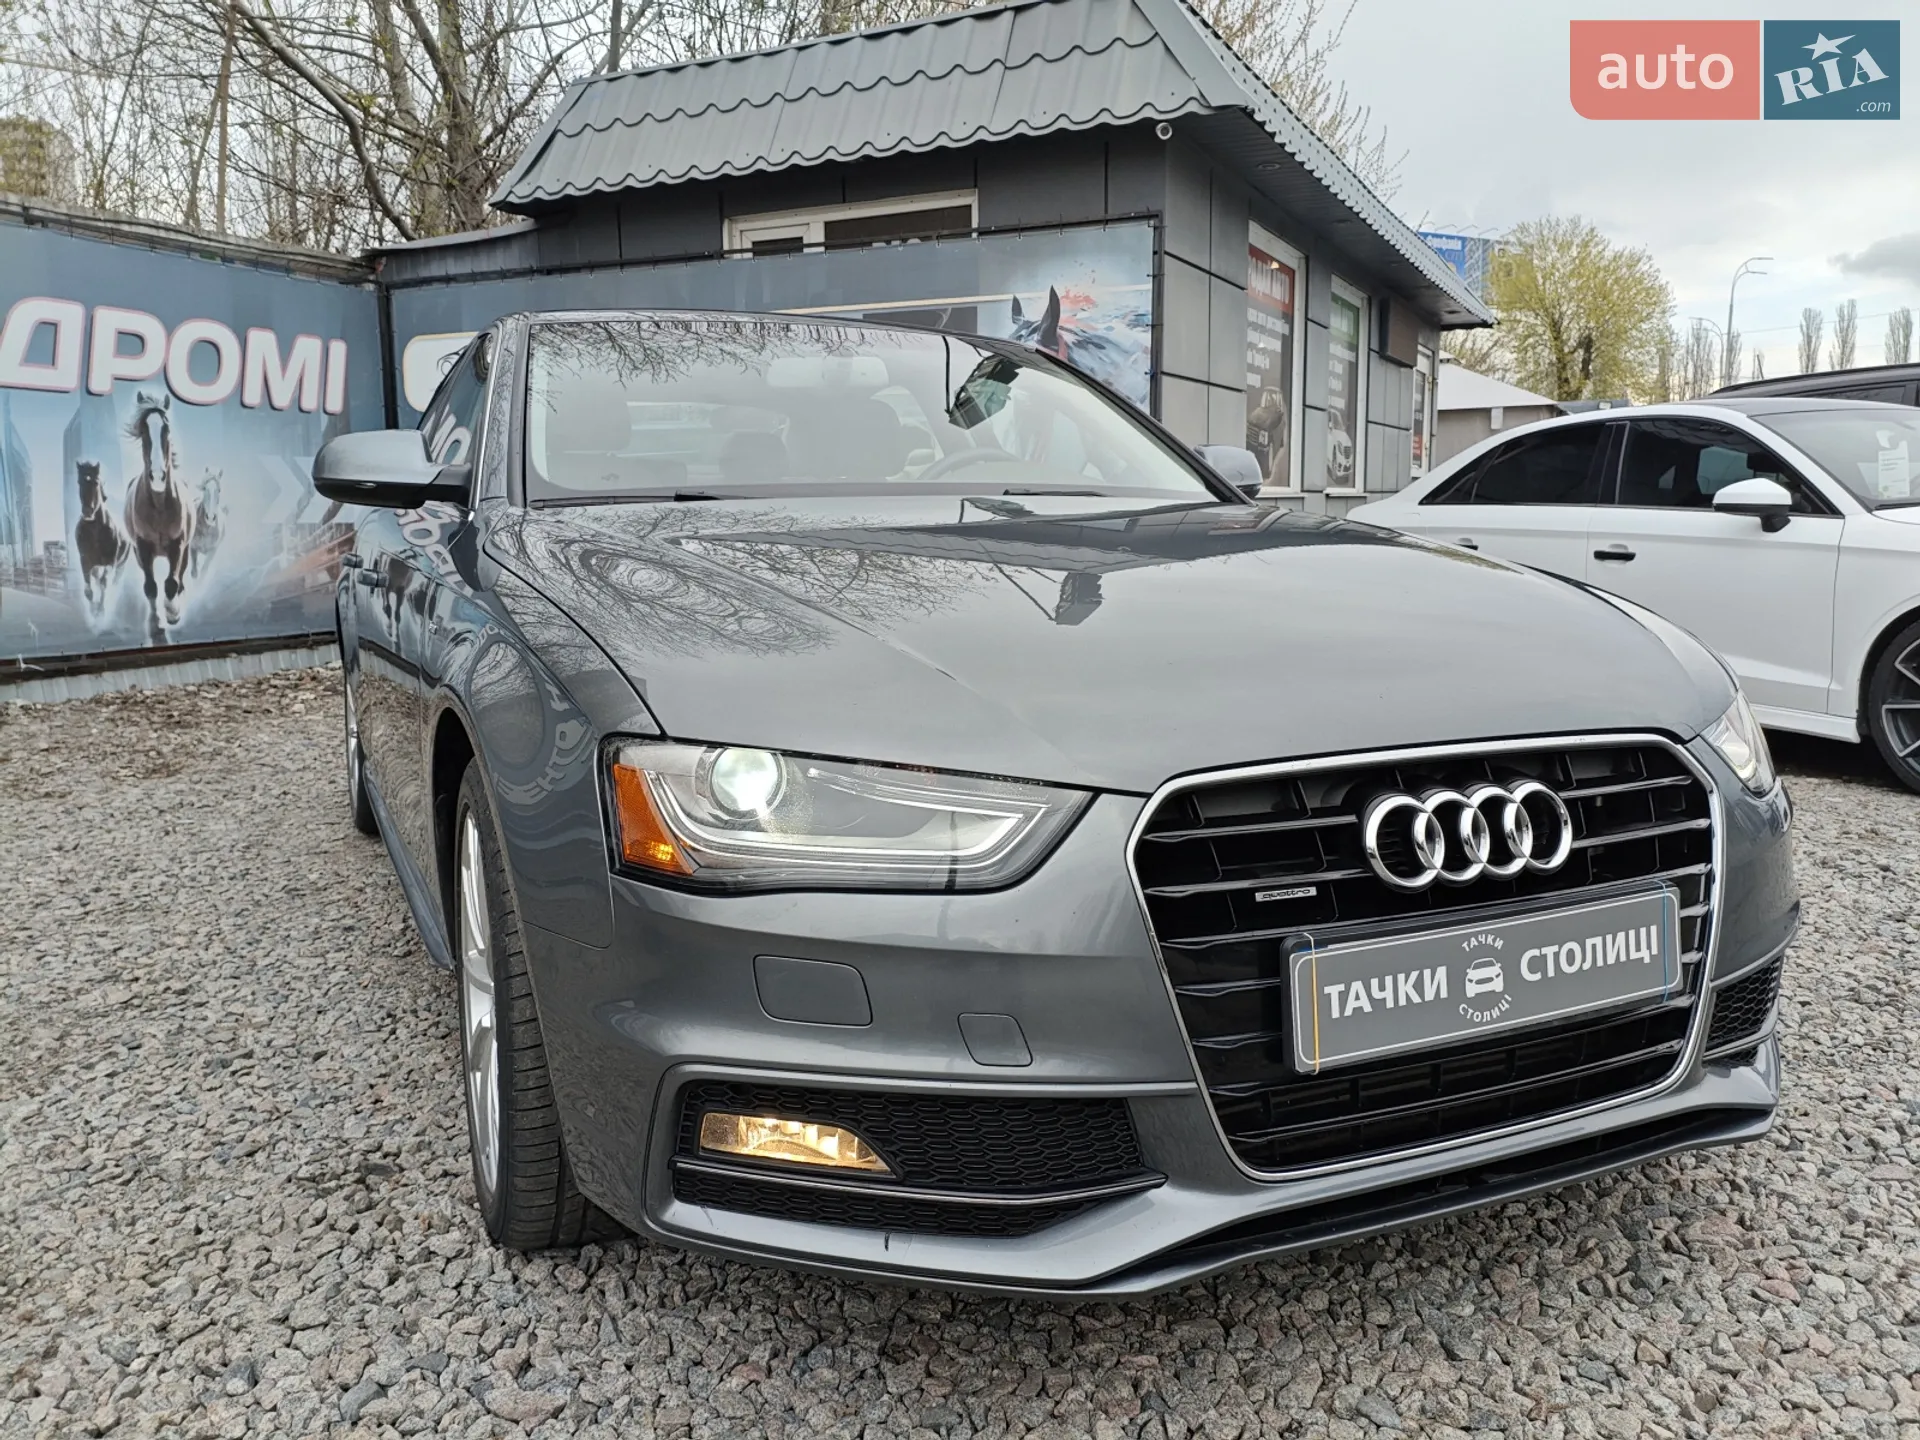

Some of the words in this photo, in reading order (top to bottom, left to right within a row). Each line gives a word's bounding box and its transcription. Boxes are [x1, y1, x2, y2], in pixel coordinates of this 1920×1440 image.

[0, 296, 347, 415] ДРОМІ
[1261, 888, 1311, 900] quattro
[1462, 933, 1504, 951] ТАЧКИ
[1323, 965, 1449, 1019] ТАЧКИ
[1520, 925, 1658, 982] СТОЛИЦІ
[1459, 993, 1512, 1023] СТОЛИЦІ
